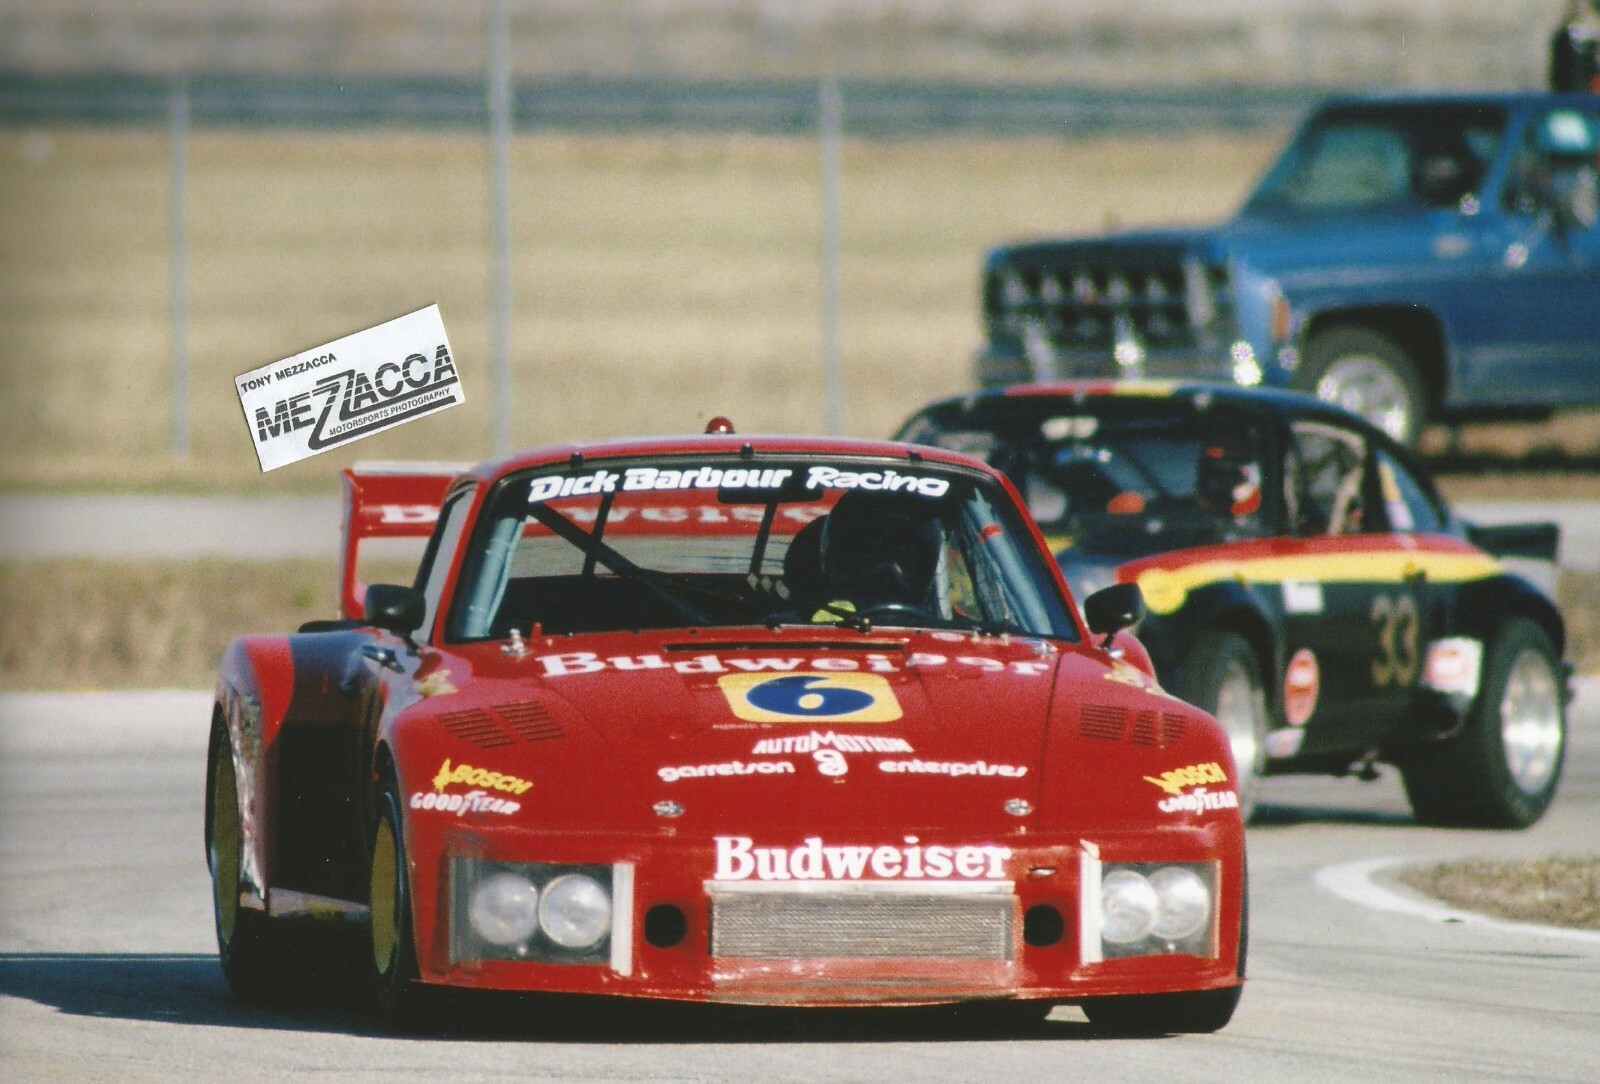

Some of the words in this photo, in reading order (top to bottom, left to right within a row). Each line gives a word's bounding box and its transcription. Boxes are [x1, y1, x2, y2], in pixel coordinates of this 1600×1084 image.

[528, 470, 620, 503] Dick
[623, 467, 793, 490] Barbour
[805, 466, 950, 497] Racing
[1371, 595, 1419, 687] 33
[534, 651, 1049, 677] Budweiser
[746, 675, 875, 716] 6
[452, 764, 534, 795] BOSCH
[657, 761, 796, 782] garretson
[878, 758, 1028, 777] enterprises
[409, 790, 521, 817] GOODYEAR
[713, 836, 1012, 880] Budweiser
